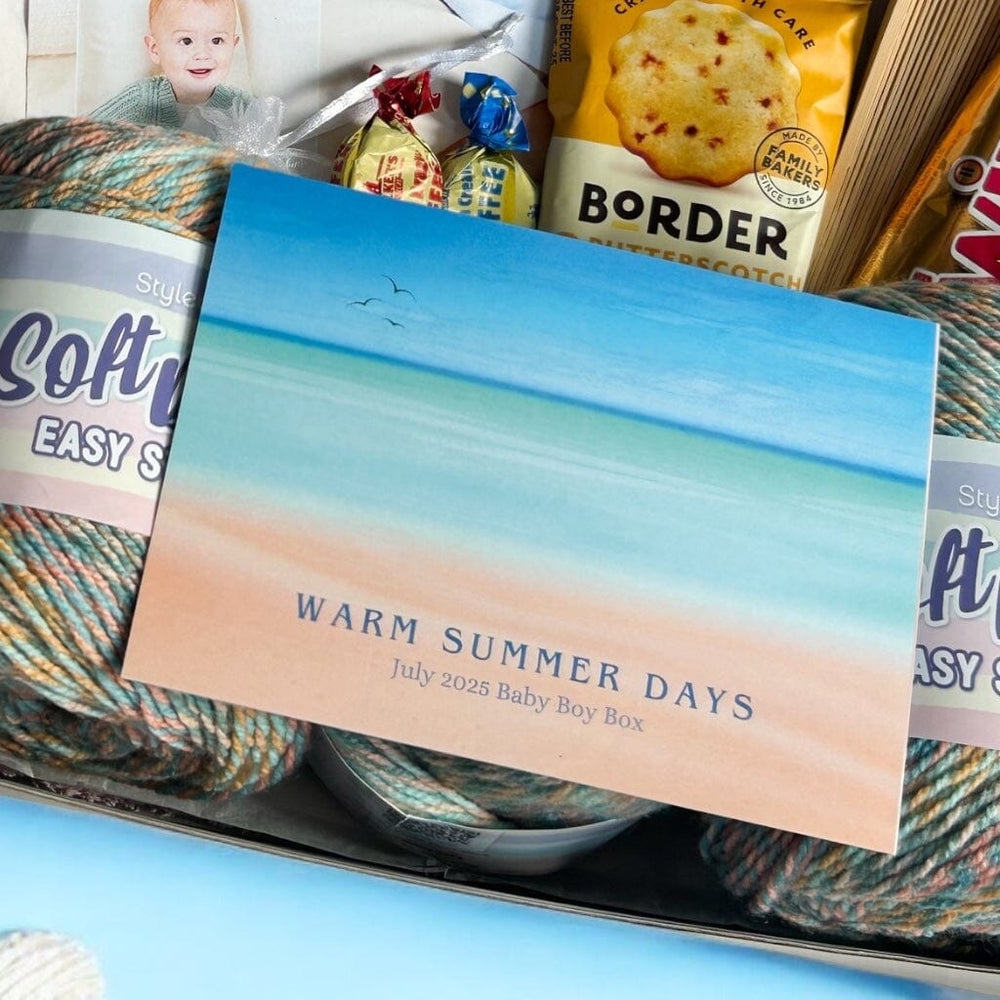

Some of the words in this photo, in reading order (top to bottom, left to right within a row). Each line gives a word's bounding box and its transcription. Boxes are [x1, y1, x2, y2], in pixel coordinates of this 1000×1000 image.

[559, 23, 573, 63] BEFORE
[774, 8, 816, 51] CARE
[767, 144, 824, 178] FAMILY
[782, 131, 812, 145] MADE
[812, 143, 824, 156] BY
[477, 165, 506, 221] FFEE
[759, 174, 784, 202] SINCE
[787, 194, 812, 206] 1984
[761, 155, 821, 192] BAKERS
[578, 182, 788, 261] BORDER
[31, 414, 134, 473] EASY
[295, 591, 419, 645] WARM
[441, 626, 621, 692] SUMMER
[643, 672, 755, 722] DAYS
[913, 645, 984, 692] ASY
[390, 657, 436, 688] July
[441, 671, 490, 698] 2025
[496, 681, 551, 715] Baby
[555, 694, 598, 726] Boy
[603, 705, 646, 733] Box
